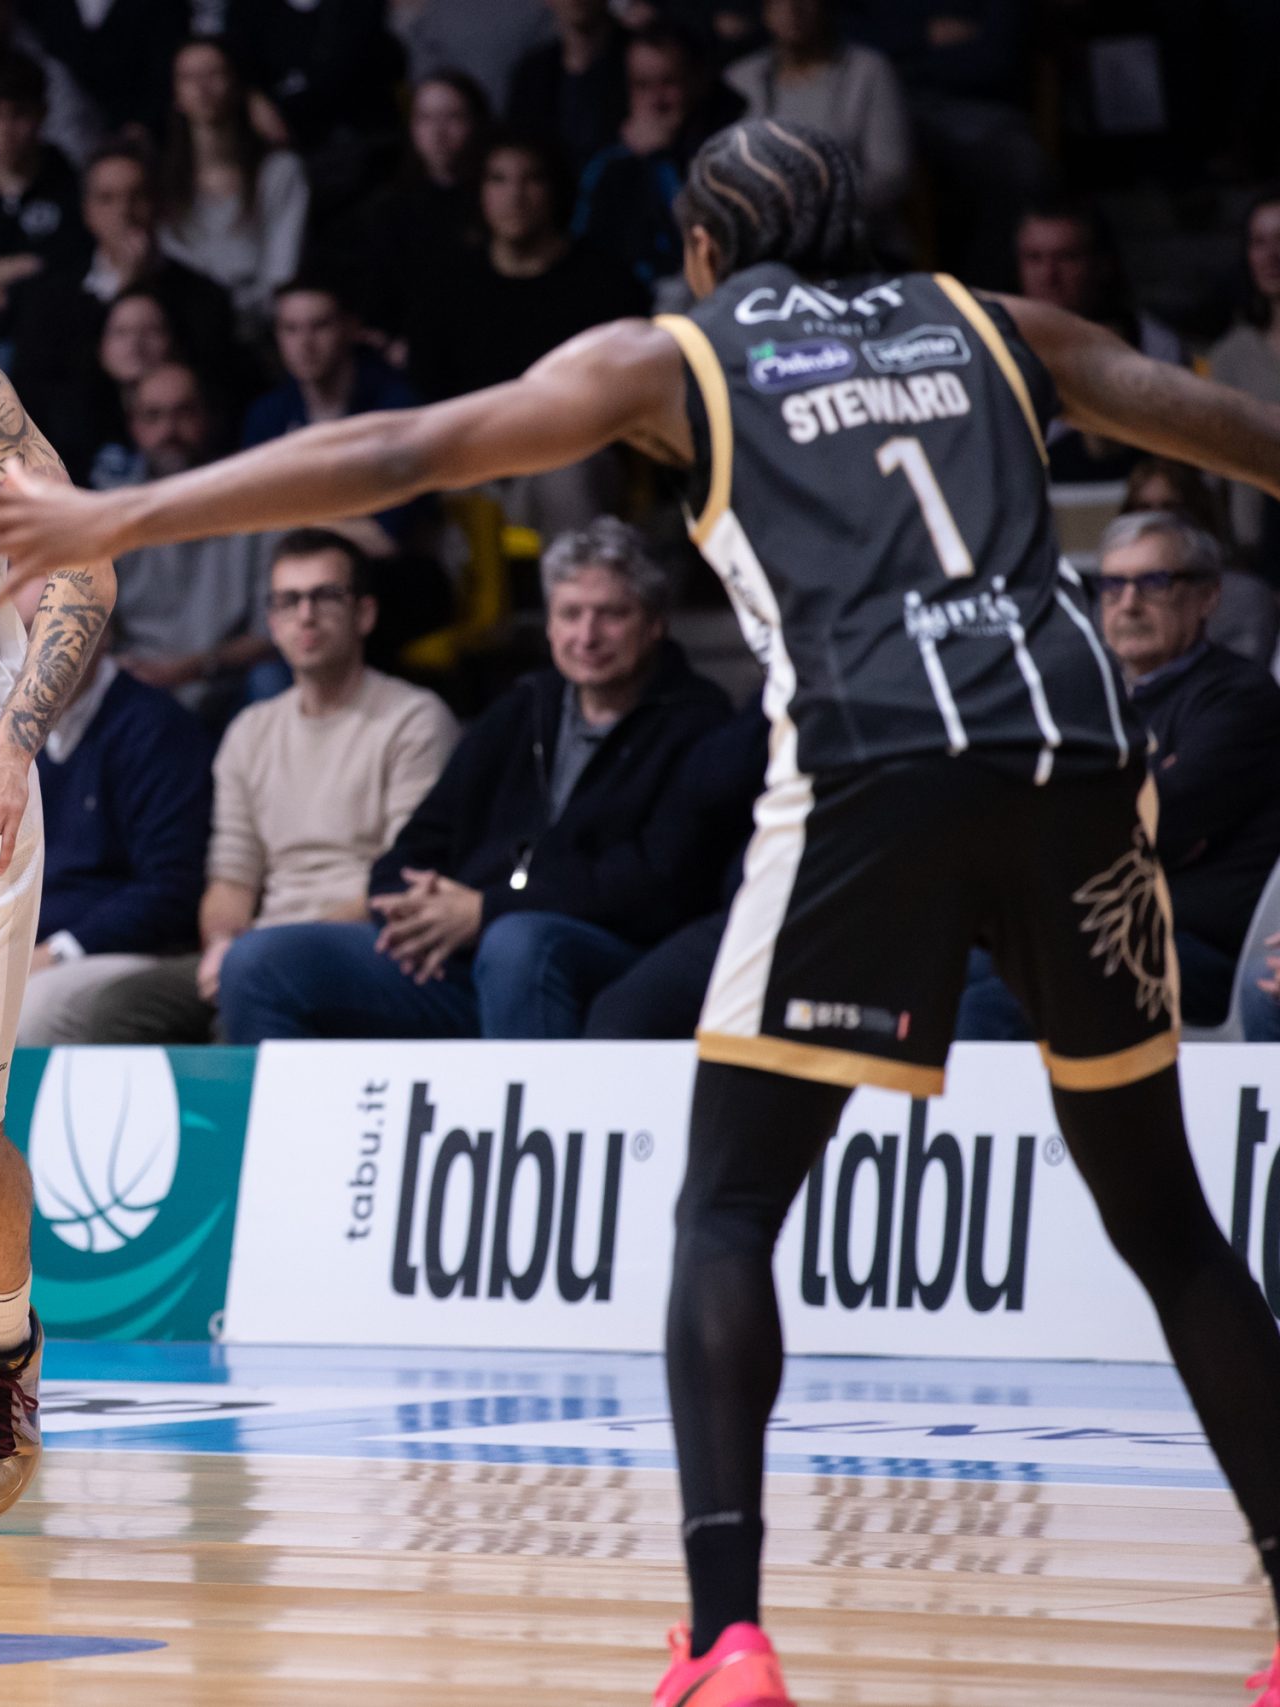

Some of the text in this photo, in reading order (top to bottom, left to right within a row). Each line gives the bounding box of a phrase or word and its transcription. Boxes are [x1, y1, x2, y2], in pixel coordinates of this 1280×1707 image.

[781, 371, 971, 444] STEWARD
[875, 436, 974, 578] 1
[345, 1079, 389, 1242] tabu.it
[391, 1081, 625, 1304] tabu
